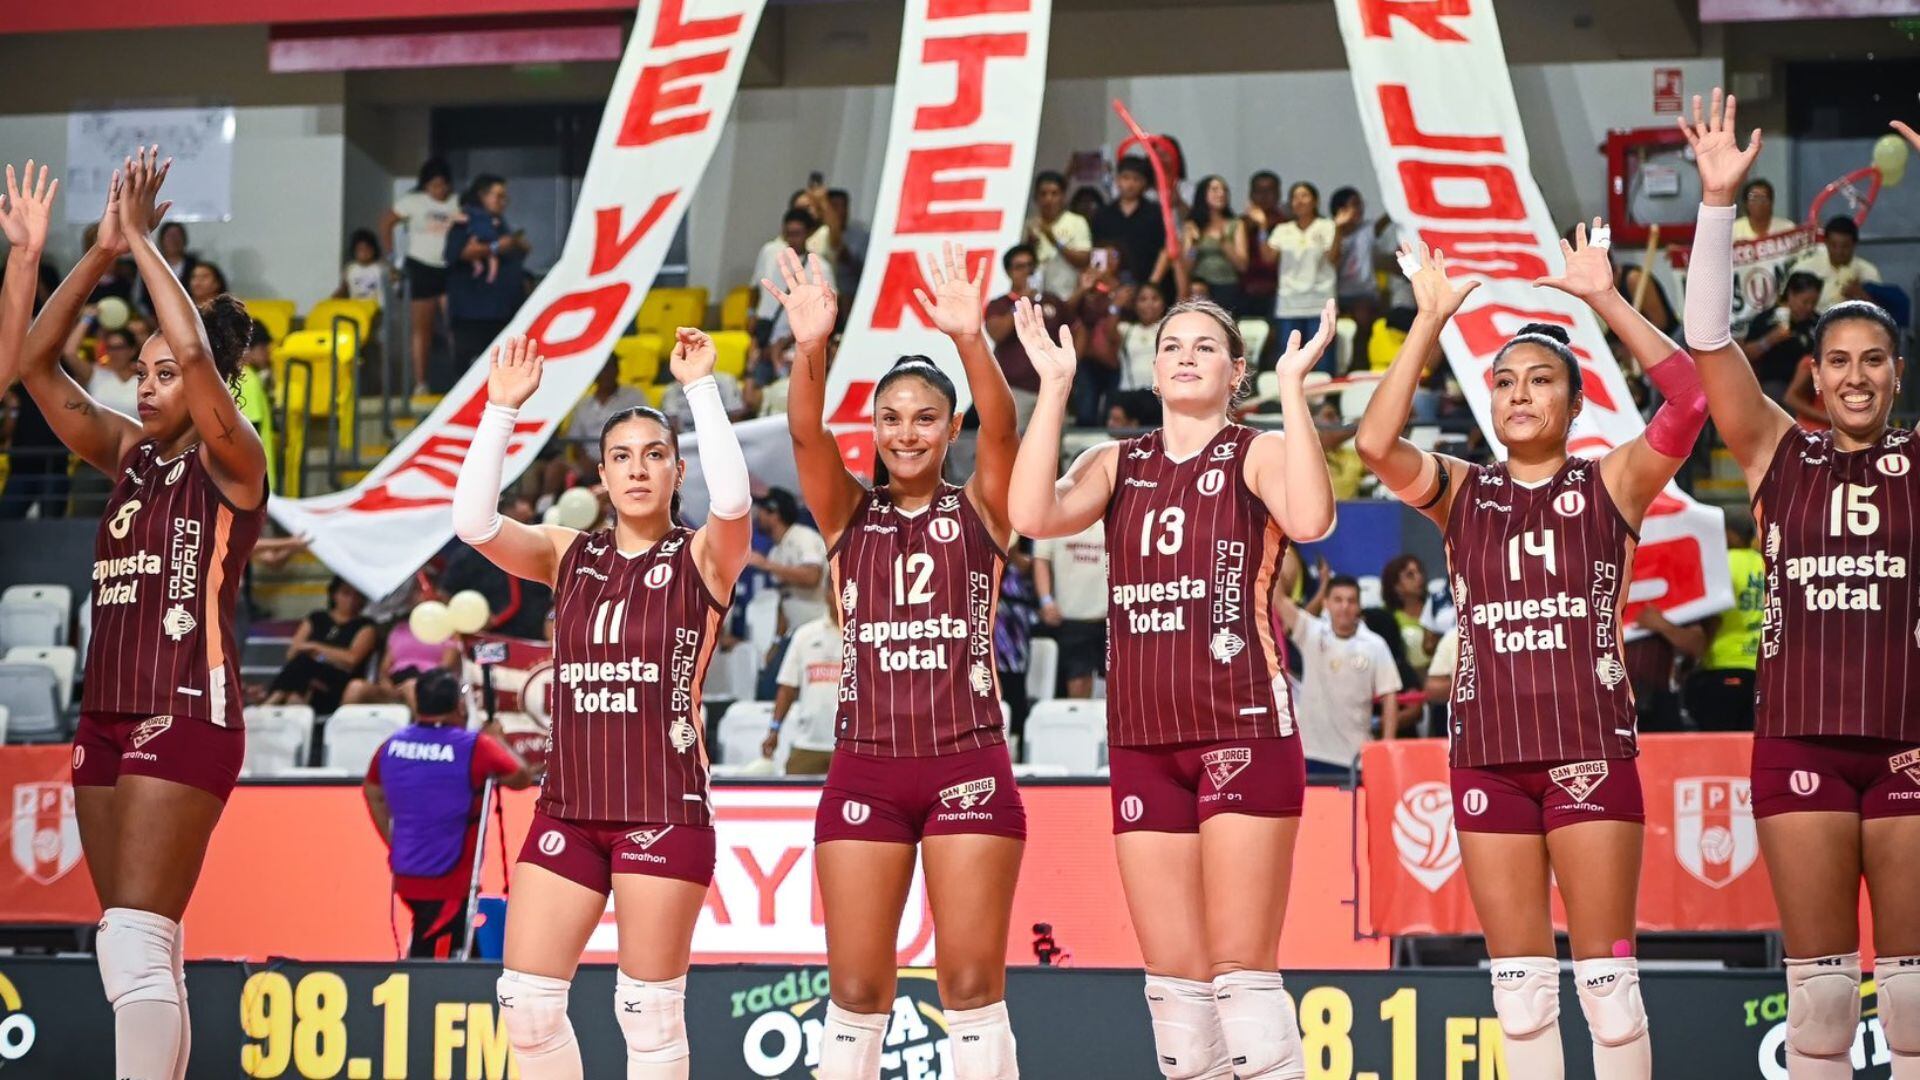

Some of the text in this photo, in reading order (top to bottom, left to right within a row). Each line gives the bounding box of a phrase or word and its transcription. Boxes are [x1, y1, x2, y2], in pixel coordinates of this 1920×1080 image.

[870, 0, 1030, 330] JEN
[109, 500, 142, 539] 8
[1830, 482, 1880, 537] 15
[1140, 506, 1186, 557] 13
[92, 549, 162, 585] apuesta
[169, 516, 185, 600] COLECTIVO
[181, 518, 201, 600] WORLD
[1508, 529, 1557, 582] 14
[1785, 550, 1907, 586] apuesta
[96, 579, 139, 607] total
[894, 552, 937, 606] 12
[1112, 575, 1206, 610] apuesta
[1213, 539, 1229, 624] COLECTIVO
[1225, 540, 1246, 623] WORLD
[969, 571, 980, 656] COLECTIVO
[978, 573, 989, 656] WORLD
[1472, 591, 1588, 630] apuesta
[1804, 583, 1882, 612] total
[593, 597, 626, 645] 11
[859, 613, 968, 649] apuesta
[1128, 606, 1185, 634] total
[1493, 623, 1567, 654] total
[559, 656, 660, 689] apuesta
[671, 627, 686, 712] COLECTIVO
[679, 629, 699, 711] WORLD
[879, 643, 948, 673] total
[573, 687, 638, 713] total
[388, 740, 455, 763] PRENSA
[1203, 752, 1219, 765] SAN
[1221, 748, 1250, 762] JORGE
[1573, 761, 1607, 775] JORGE
[1891, 752, 1914, 769] SAN
[962, 778, 993, 794] JORGE
[1550, 767, 1572, 780] SAN
[1200, 791, 1242, 802] maraton
[937, 811, 993, 822] marathon
[621, 851, 667, 864] marathon
[1497, 969, 1526, 979] MTD
[1586, 974, 1616, 986] MTD
[731, 969, 830, 1018] radio
[240, 970, 524, 1080] 98.1 FM
[836, 1033, 856, 1043] MTD
[962, 1034, 980, 1043] MTD
[1287, 985, 1417, 1080] 8.1
